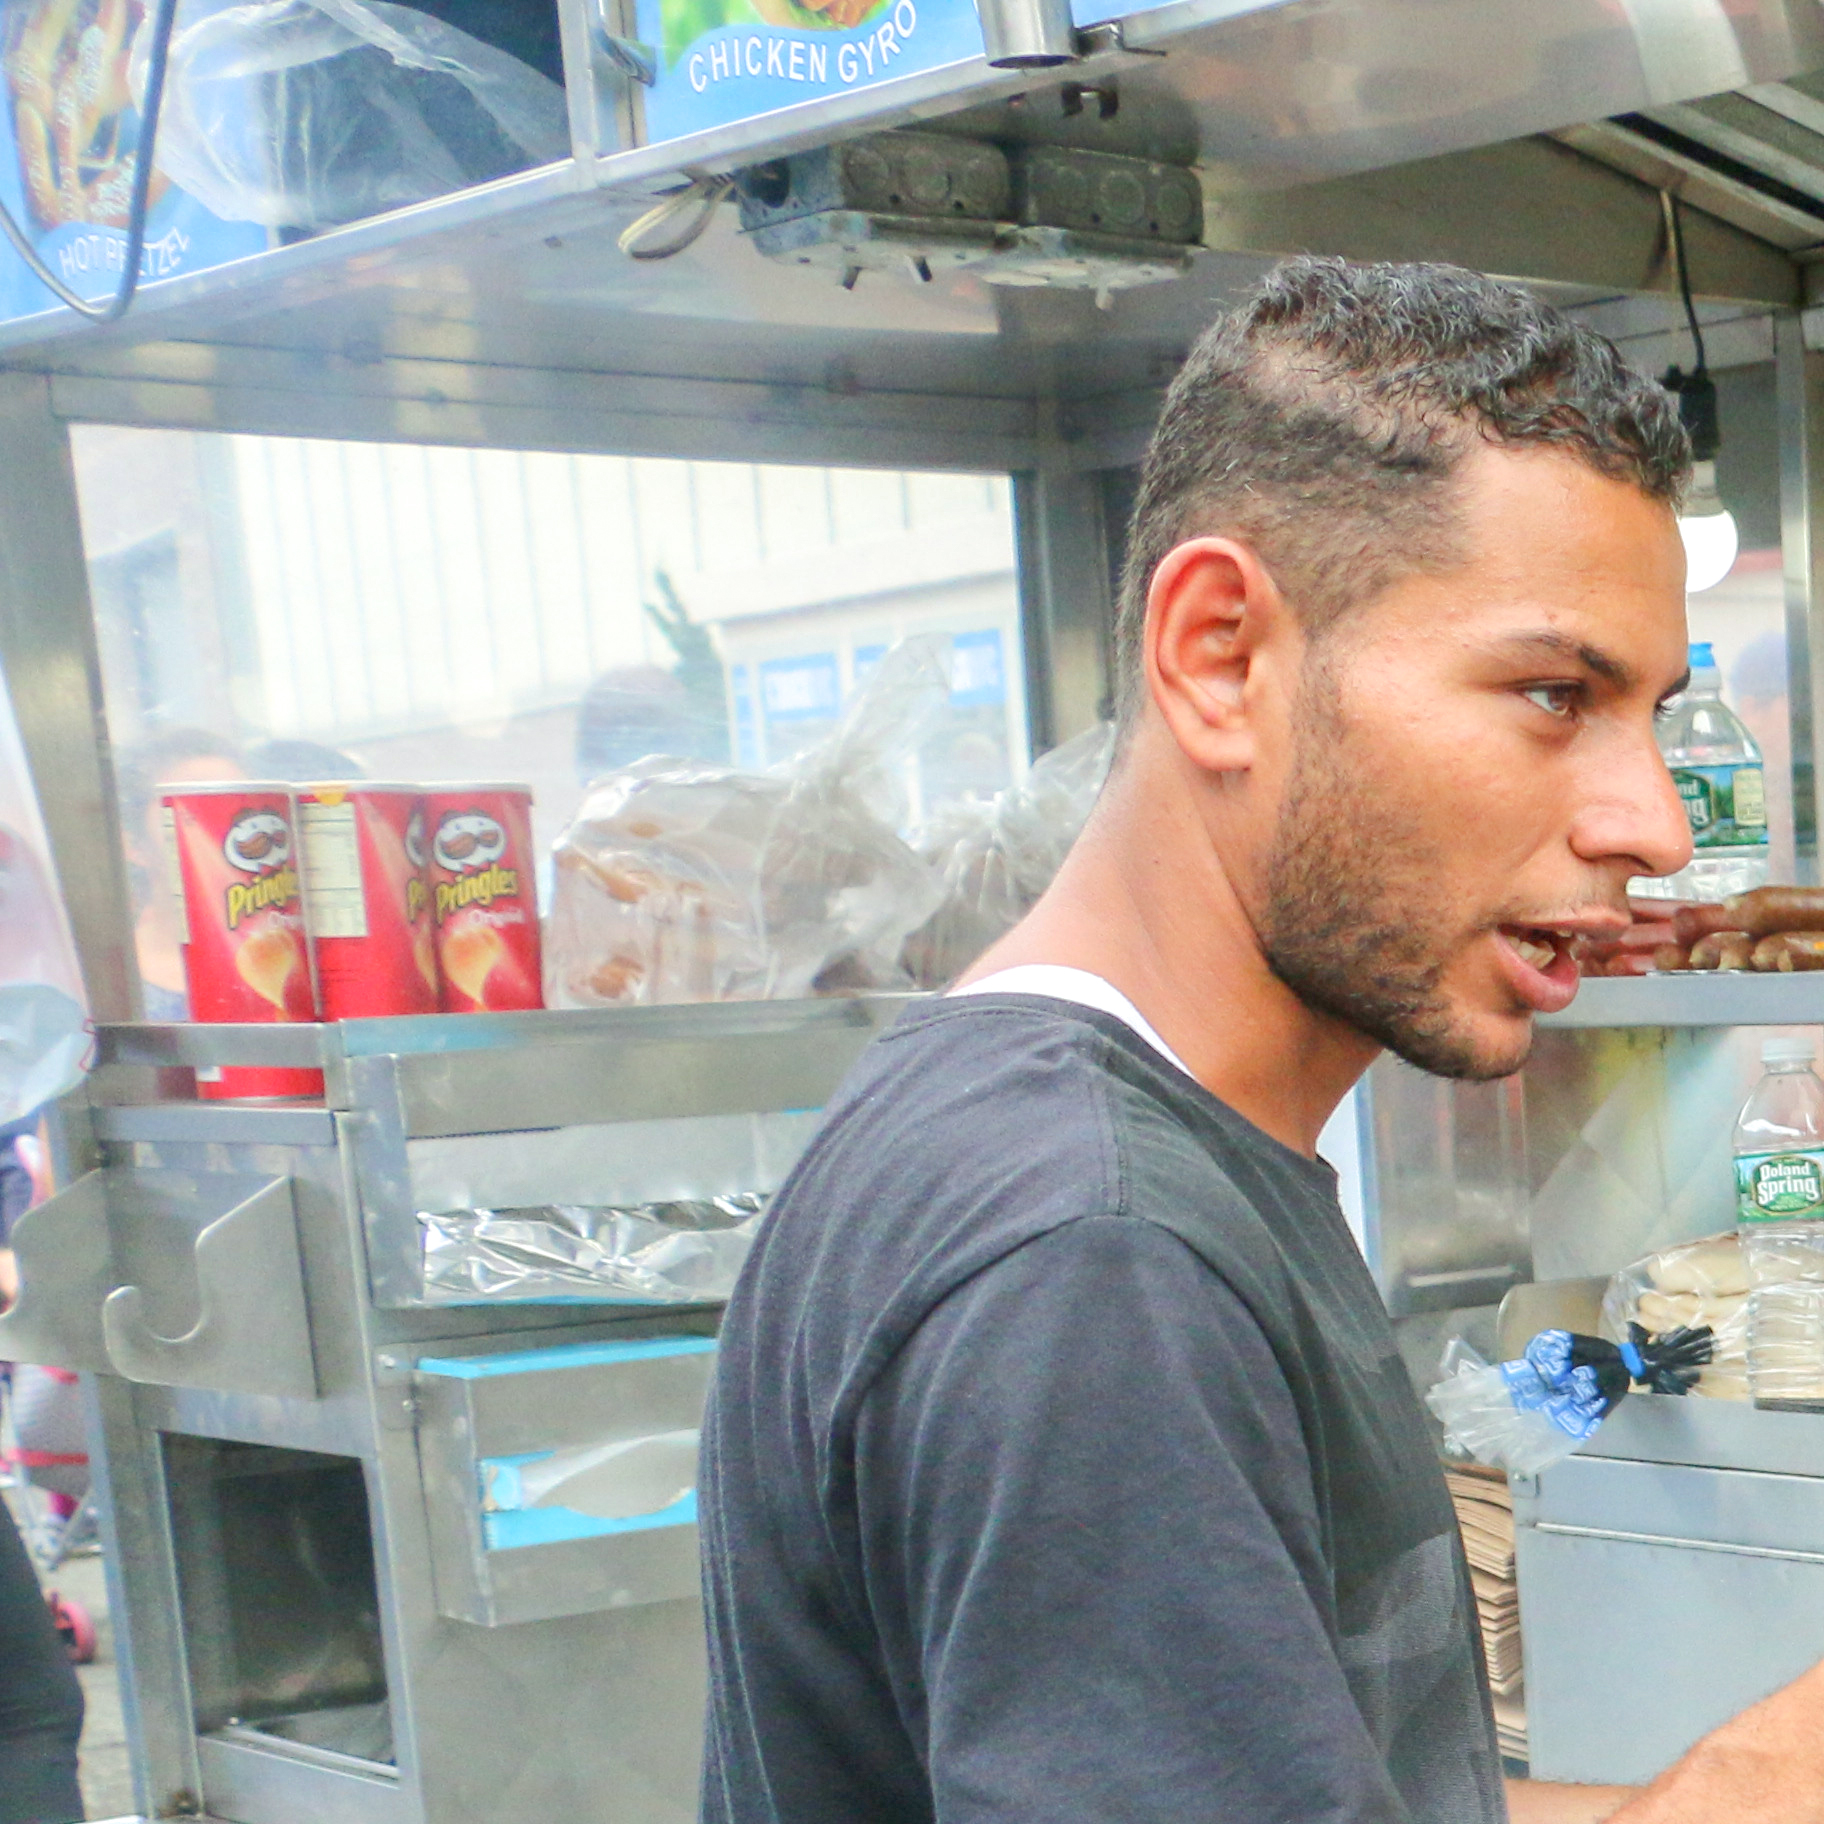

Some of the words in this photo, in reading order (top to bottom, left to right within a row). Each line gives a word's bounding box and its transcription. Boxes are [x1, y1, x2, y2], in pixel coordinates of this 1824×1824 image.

[689, 36, 827, 93] CHICKEN
[838, 0, 917, 83] GYRO
[59, 235, 100, 278] HOT
[106, 227, 191, 276] PRTZEL
[435, 863, 519, 928] Pringles
[1756, 1176, 1820, 1206] Spring
[1760, 1162, 1812, 1181] Poland
